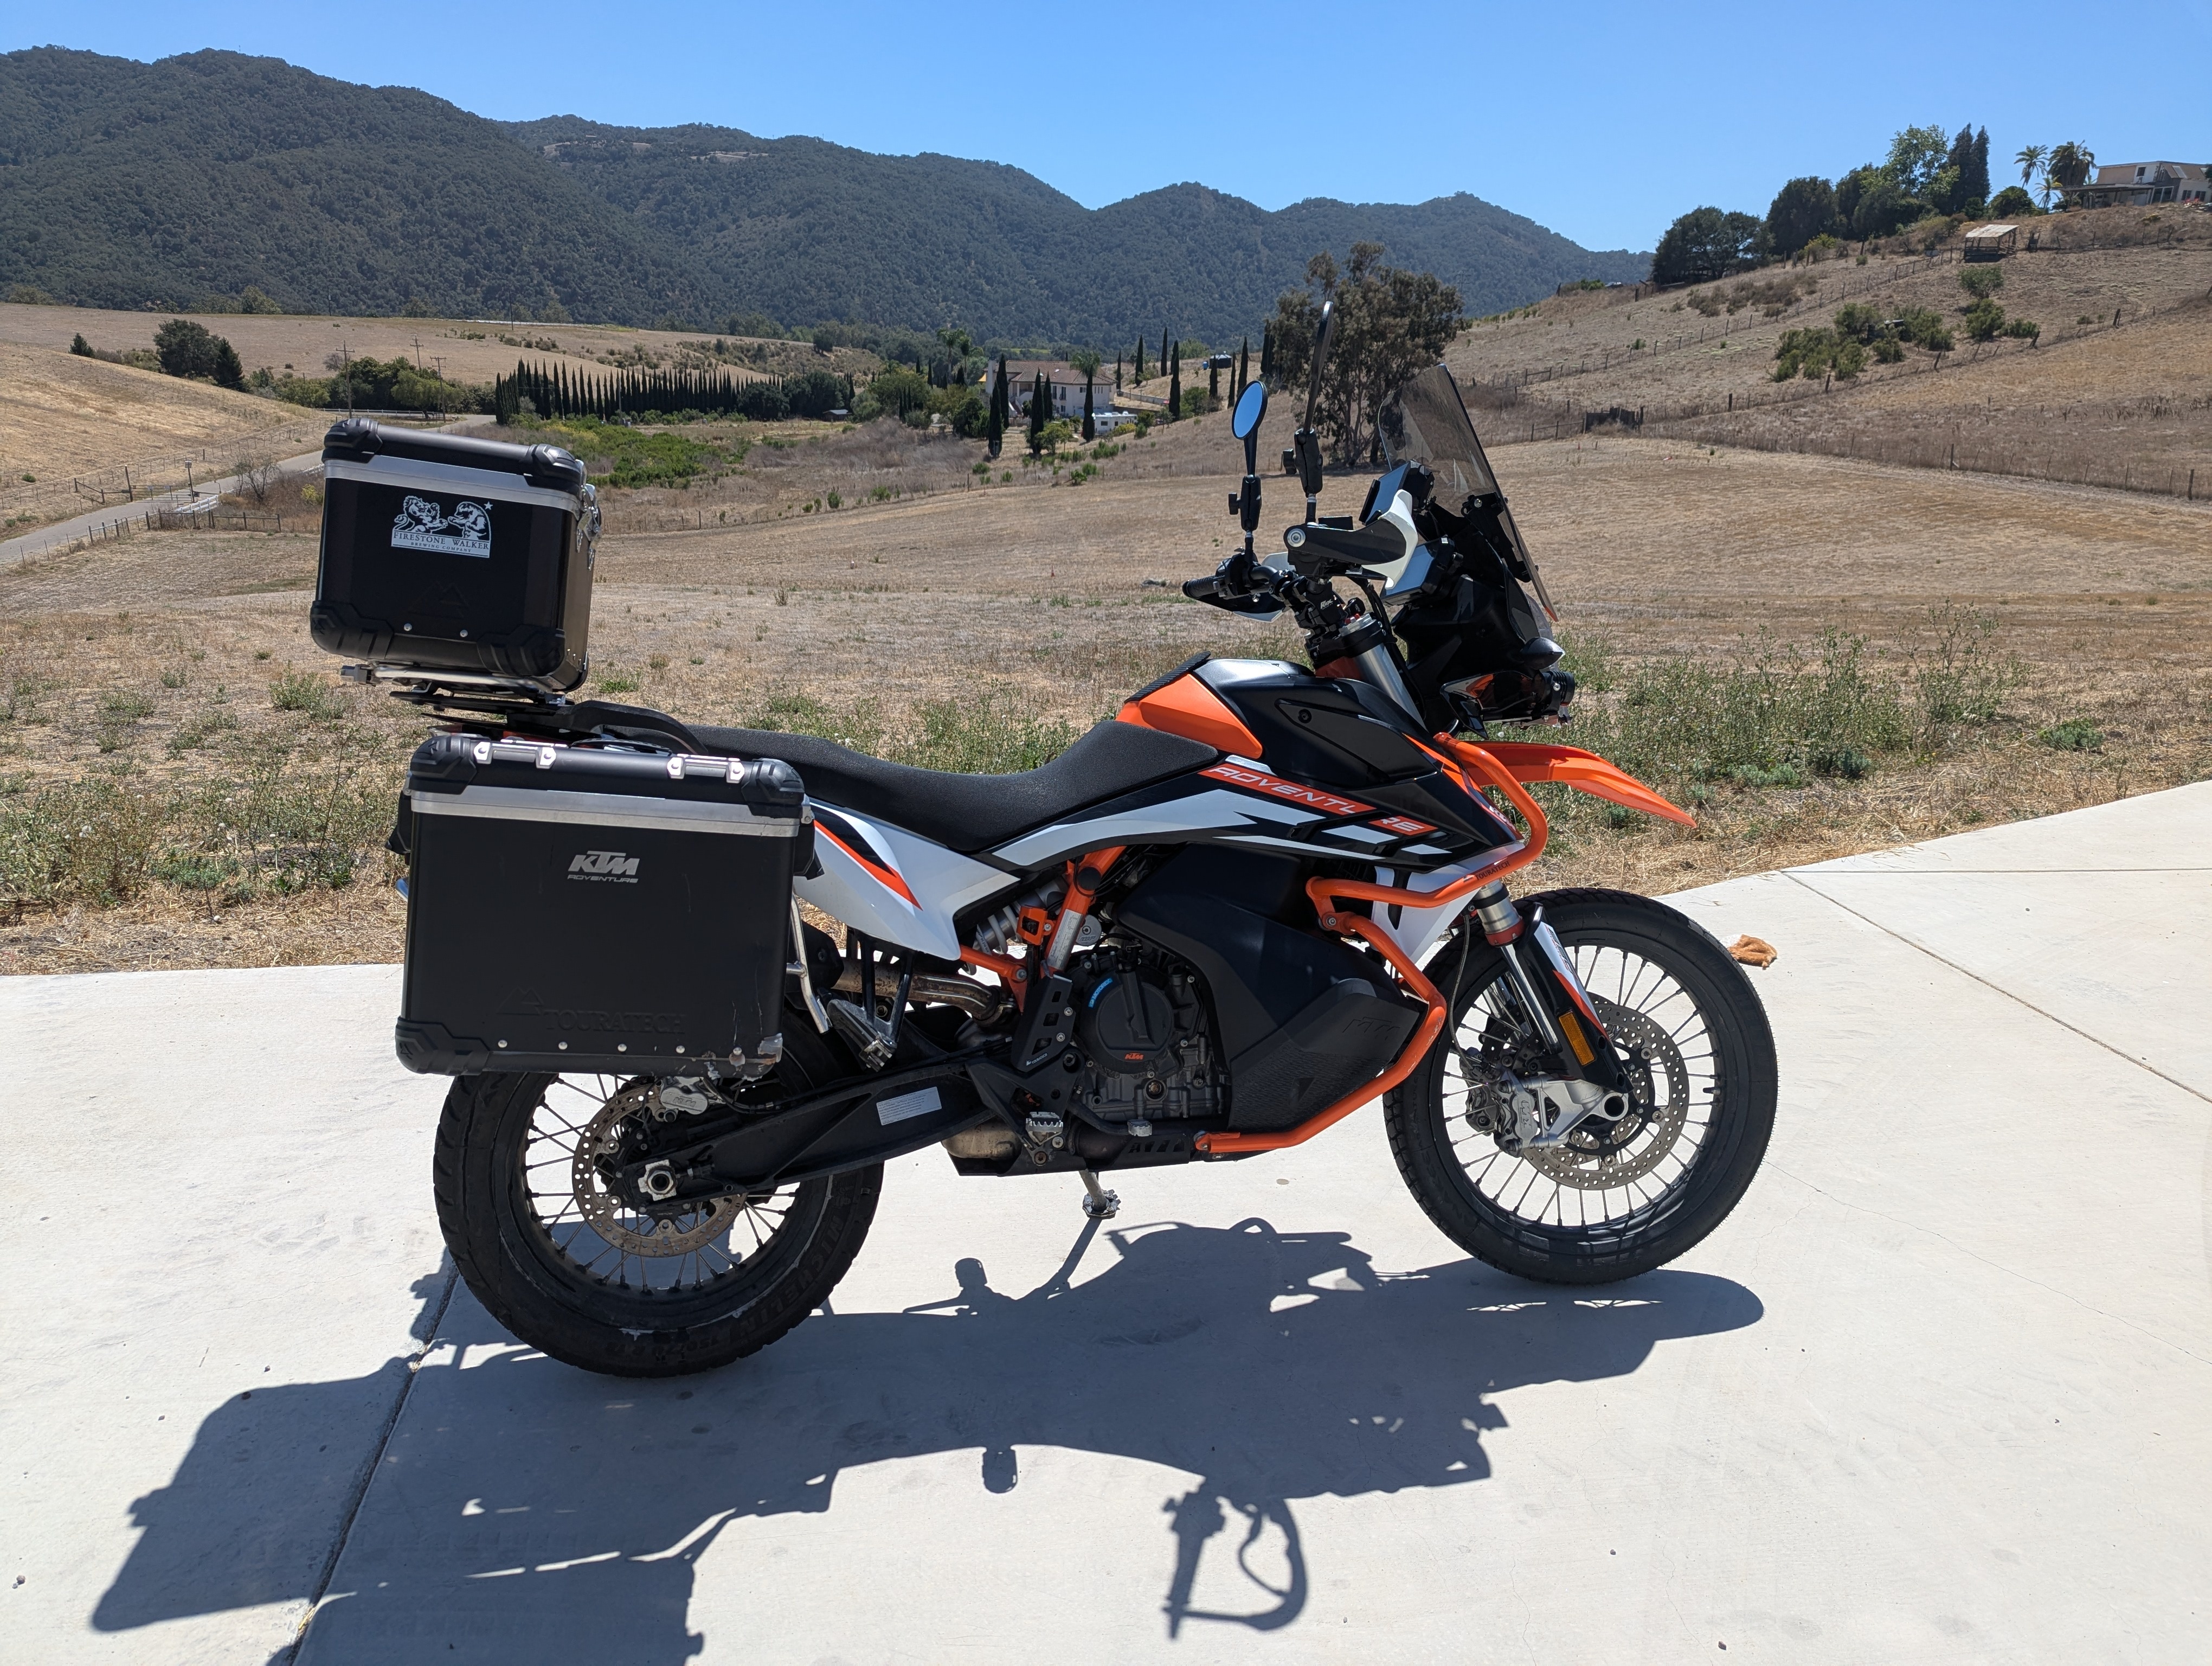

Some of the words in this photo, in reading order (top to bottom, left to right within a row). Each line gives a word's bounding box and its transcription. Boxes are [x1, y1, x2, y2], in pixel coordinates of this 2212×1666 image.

[393, 531, 446, 544] FIRESTONE
[452, 539, 489, 550] WALKER
[568, 850, 640, 875] KTM
[1475, 861, 1510, 881] TOURATECH
[567, 874, 639, 883] ADVENTURE
[1092, 978, 1113, 1001] MOTOREX
[543, 1009, 686, 1034] TOURATECH
[673, 1095, 697, 1107] KTM
[733, 1214, 844, 1335] MICHELIN
